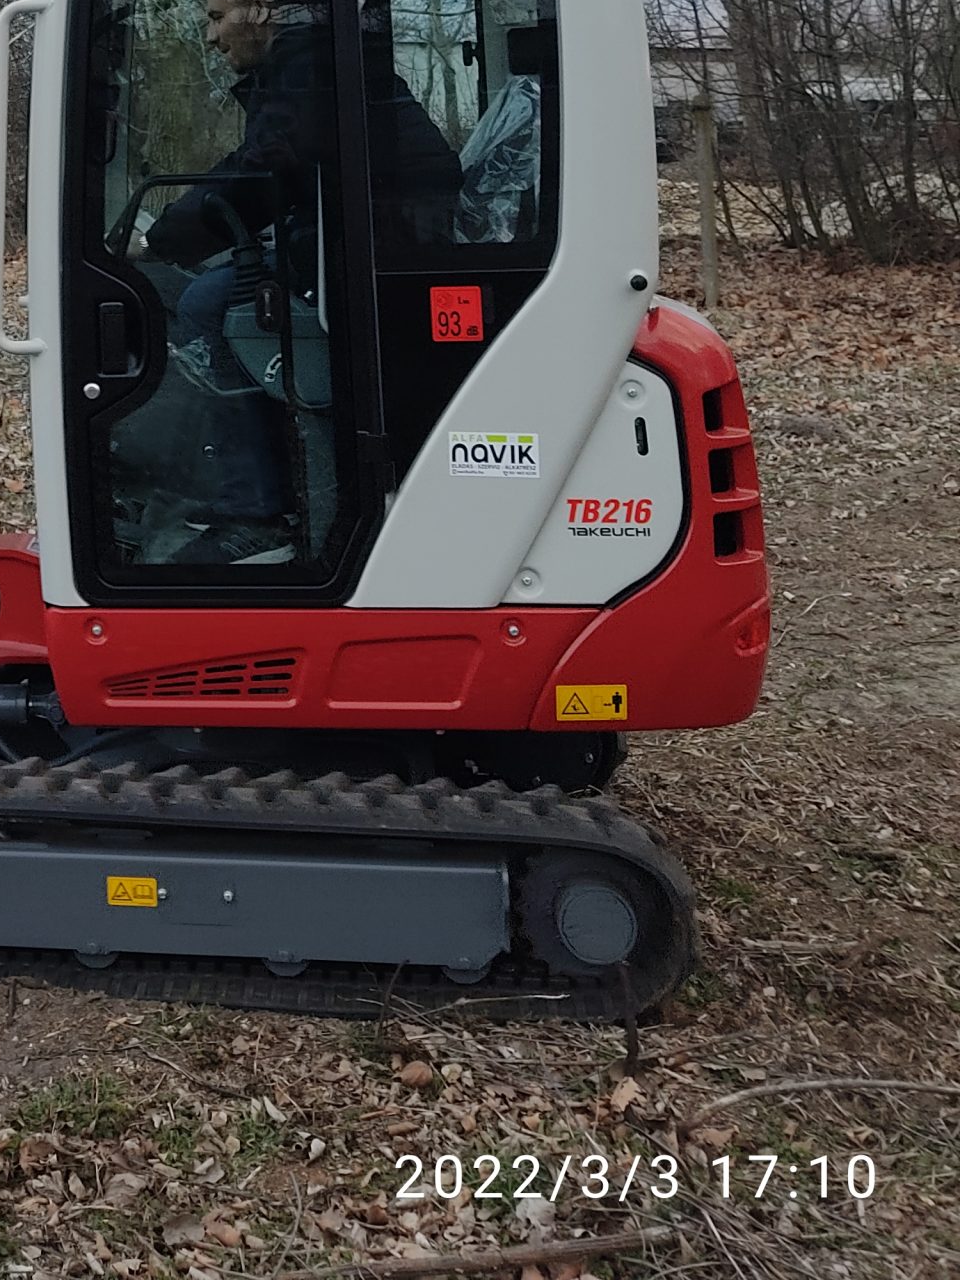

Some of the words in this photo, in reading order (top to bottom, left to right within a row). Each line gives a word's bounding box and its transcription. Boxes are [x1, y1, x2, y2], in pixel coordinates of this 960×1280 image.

[438, 311, 461, 336] 93
[466, 325, 479, 336] dB
[451, 434, 483, 442] ALFA
[566, 499, 652, 524] TB216
